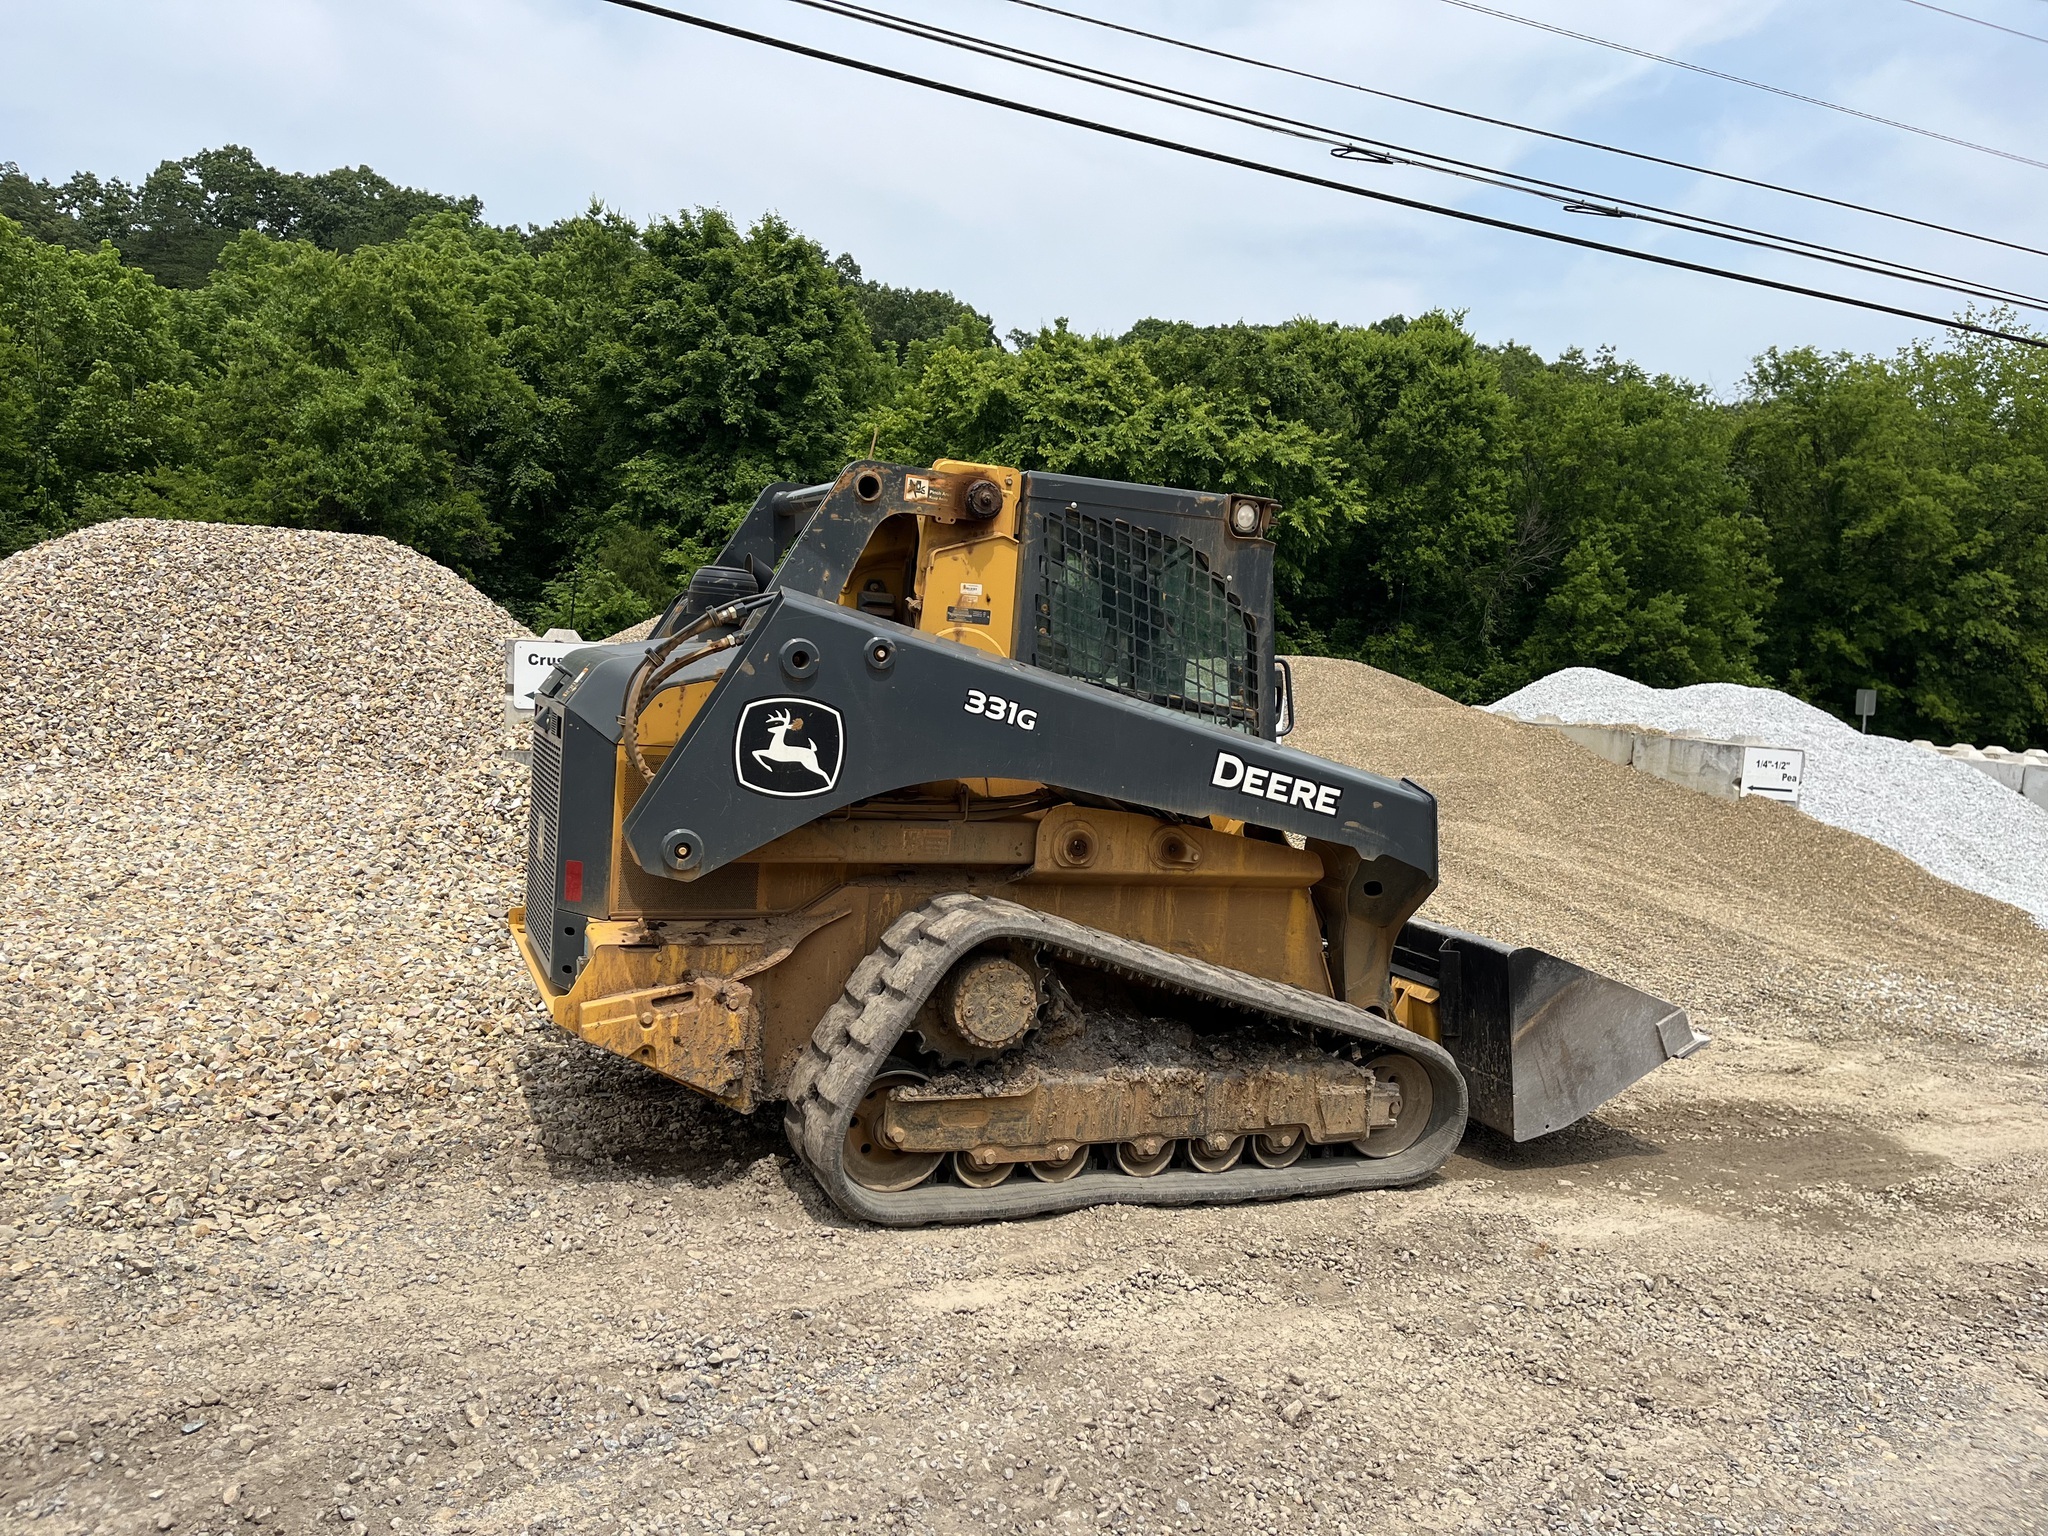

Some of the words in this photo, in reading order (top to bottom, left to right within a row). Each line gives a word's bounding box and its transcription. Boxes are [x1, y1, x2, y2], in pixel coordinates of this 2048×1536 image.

[964, 689, 1038, 730] 331G
[1756, 759, 1791, 770] 1/4"-1/2"
[1781, 773, 1797, 782] Pea
[1212, 752, 1341, 815] DEERE
